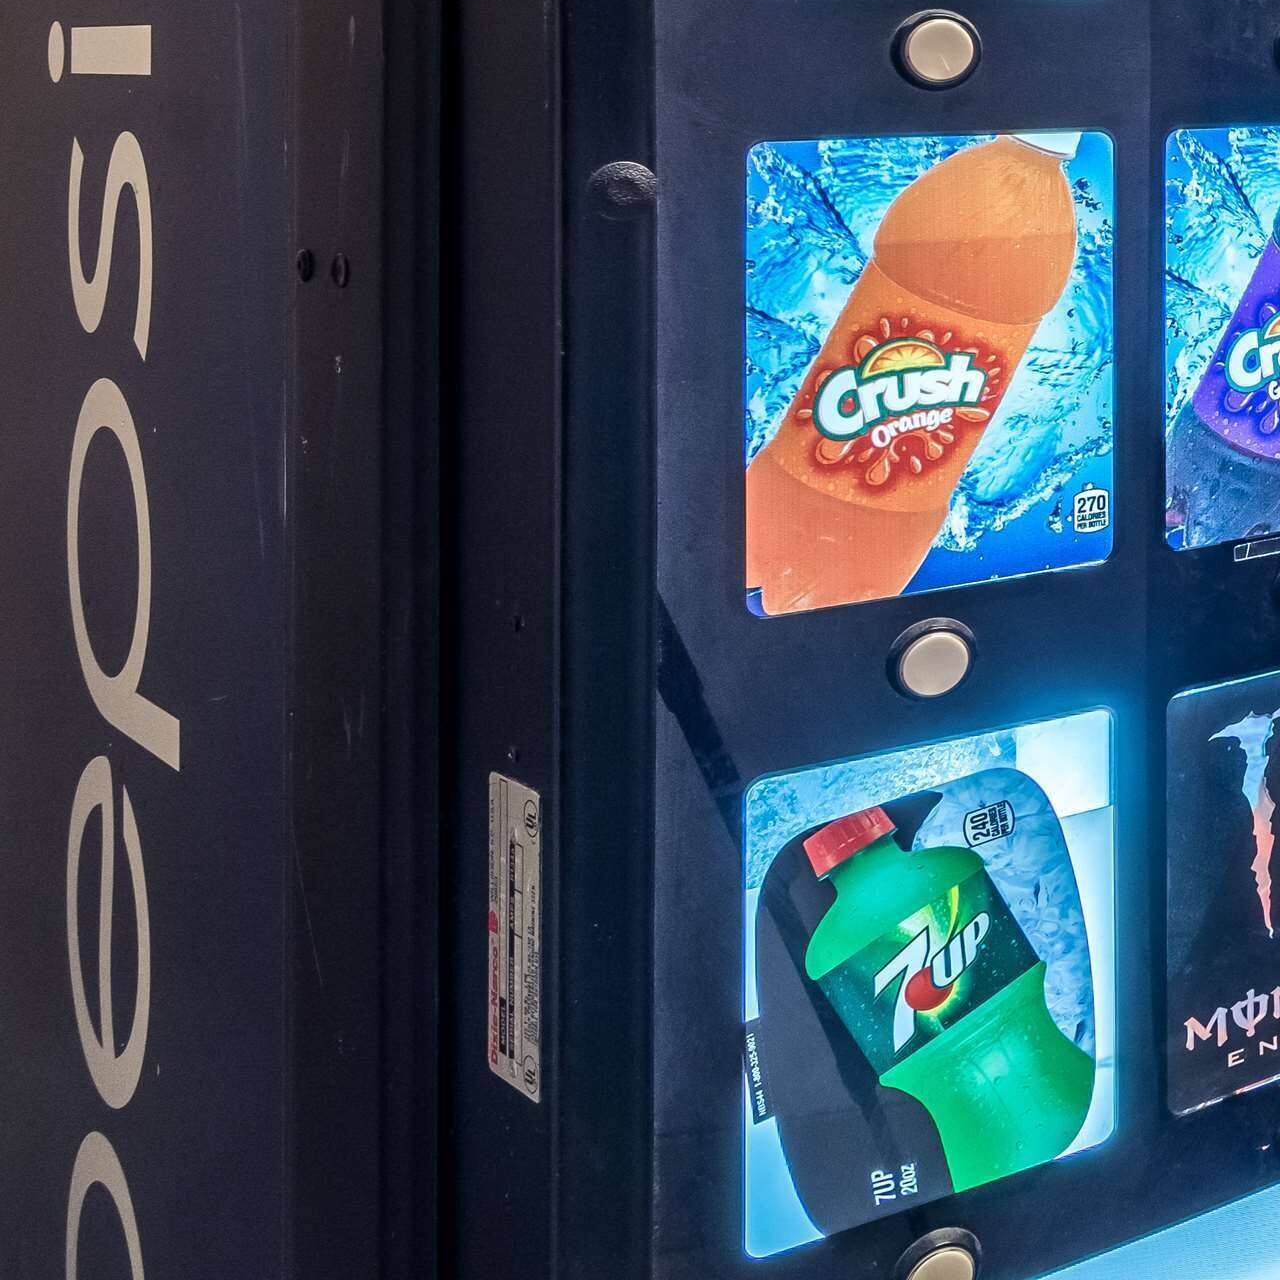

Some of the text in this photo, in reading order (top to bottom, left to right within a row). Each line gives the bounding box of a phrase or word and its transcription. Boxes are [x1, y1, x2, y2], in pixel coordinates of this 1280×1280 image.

[817, 354, 985, 437] Crush
[870, 407, 954, 449] Orange
[1076, 511, 1106, 522] CALORIES
[1078, 494, 1106, 514] 270
[1076, 520, 1106, 530] PER BOTTLE
[970, 812, 990, 841] 240
[988, 807, 1001, 837] CALORIES
[872, 912, 991, 1053] 7UP
[873, 1169, 897, 1206] 7UP
